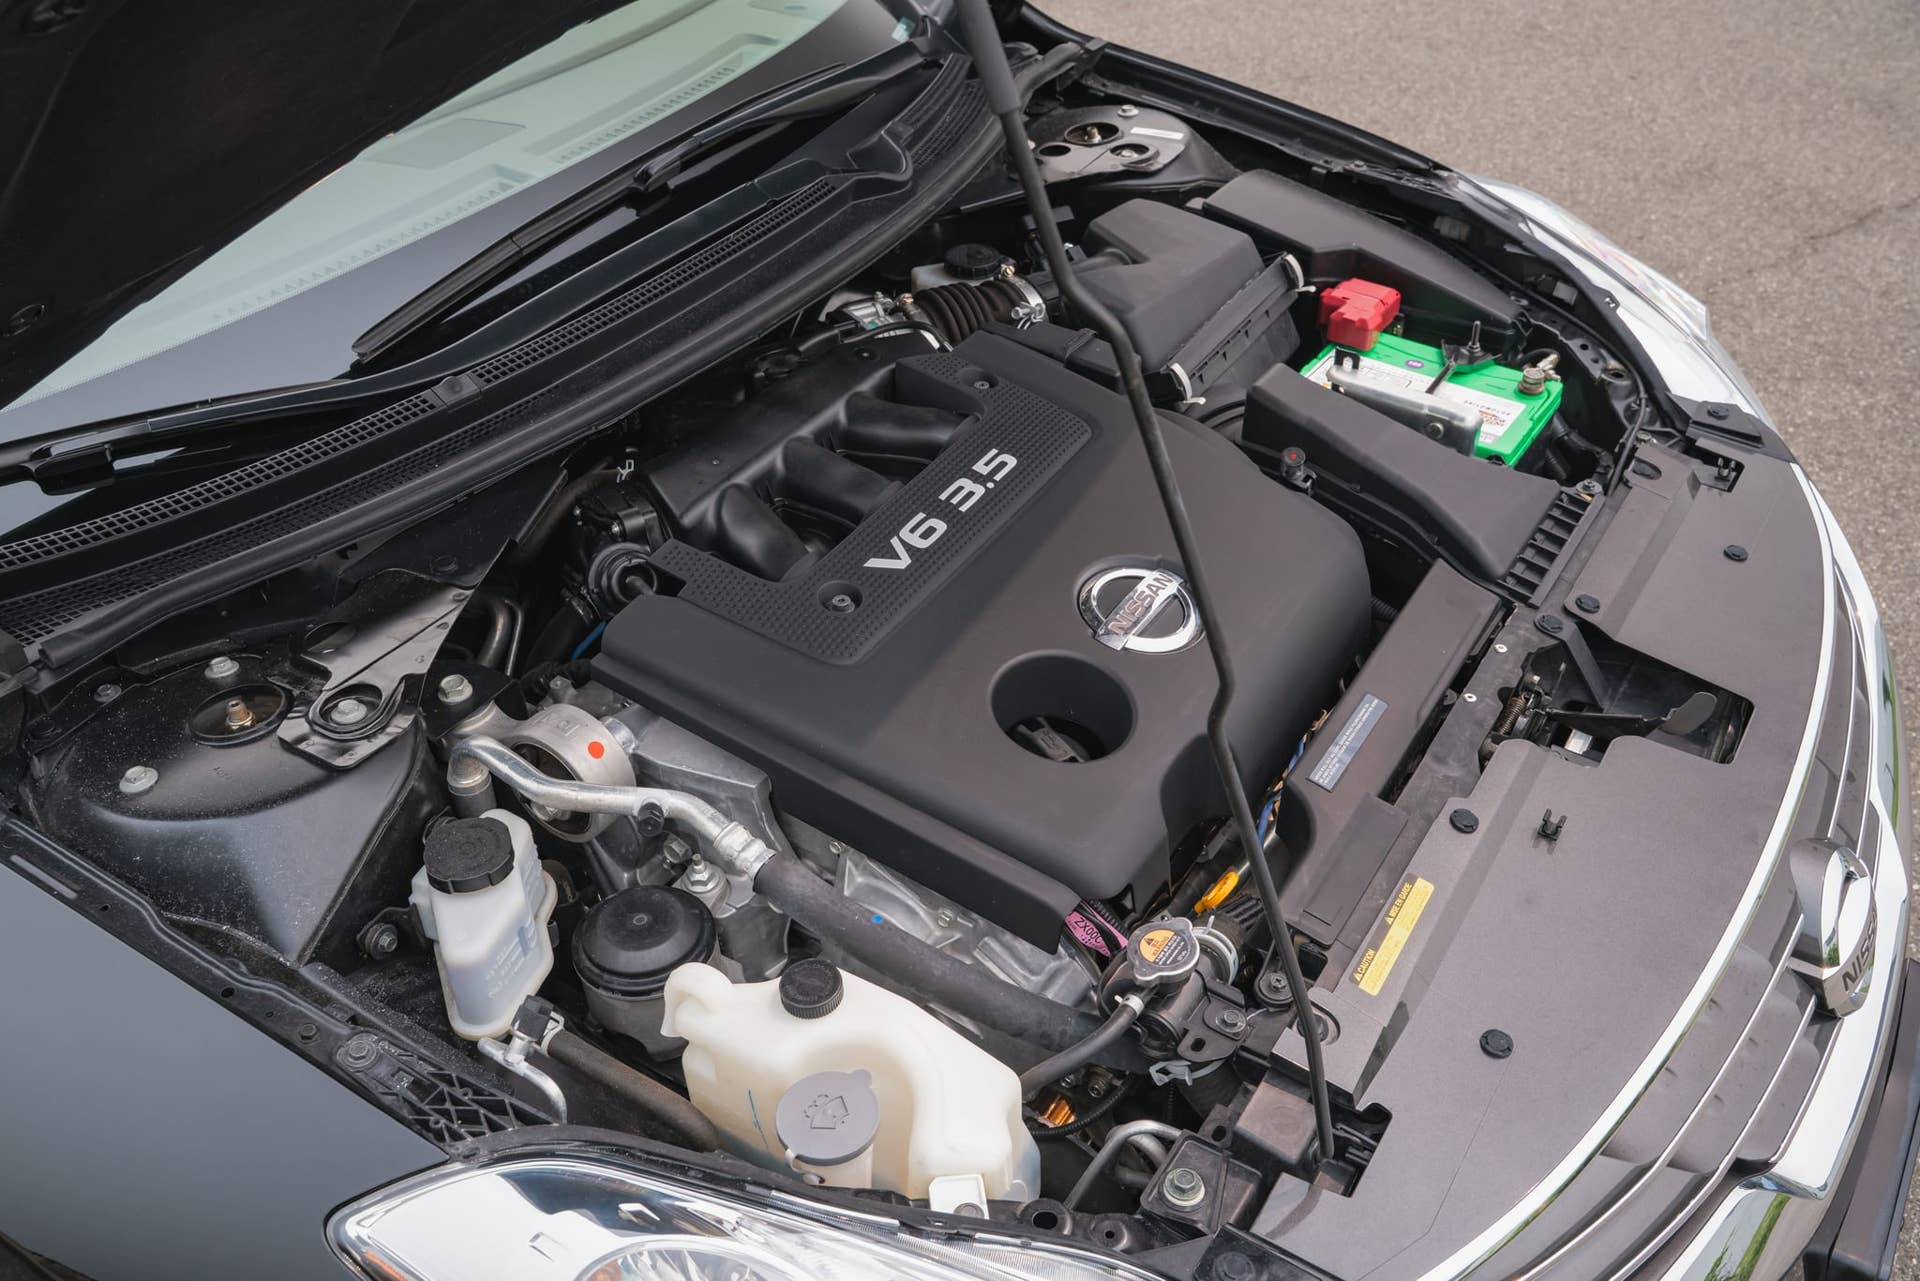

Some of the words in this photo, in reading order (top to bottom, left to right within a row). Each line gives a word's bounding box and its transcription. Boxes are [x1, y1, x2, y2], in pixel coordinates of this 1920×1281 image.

[863, 512, 948, 570] V6
[938, 448, 1018, 513] 3.5
[1107, 573, 1174, 637] NISSAN
[1357, 948, 1376, 974] CAUTION
[1842, 910, 1877, 992] NISS
